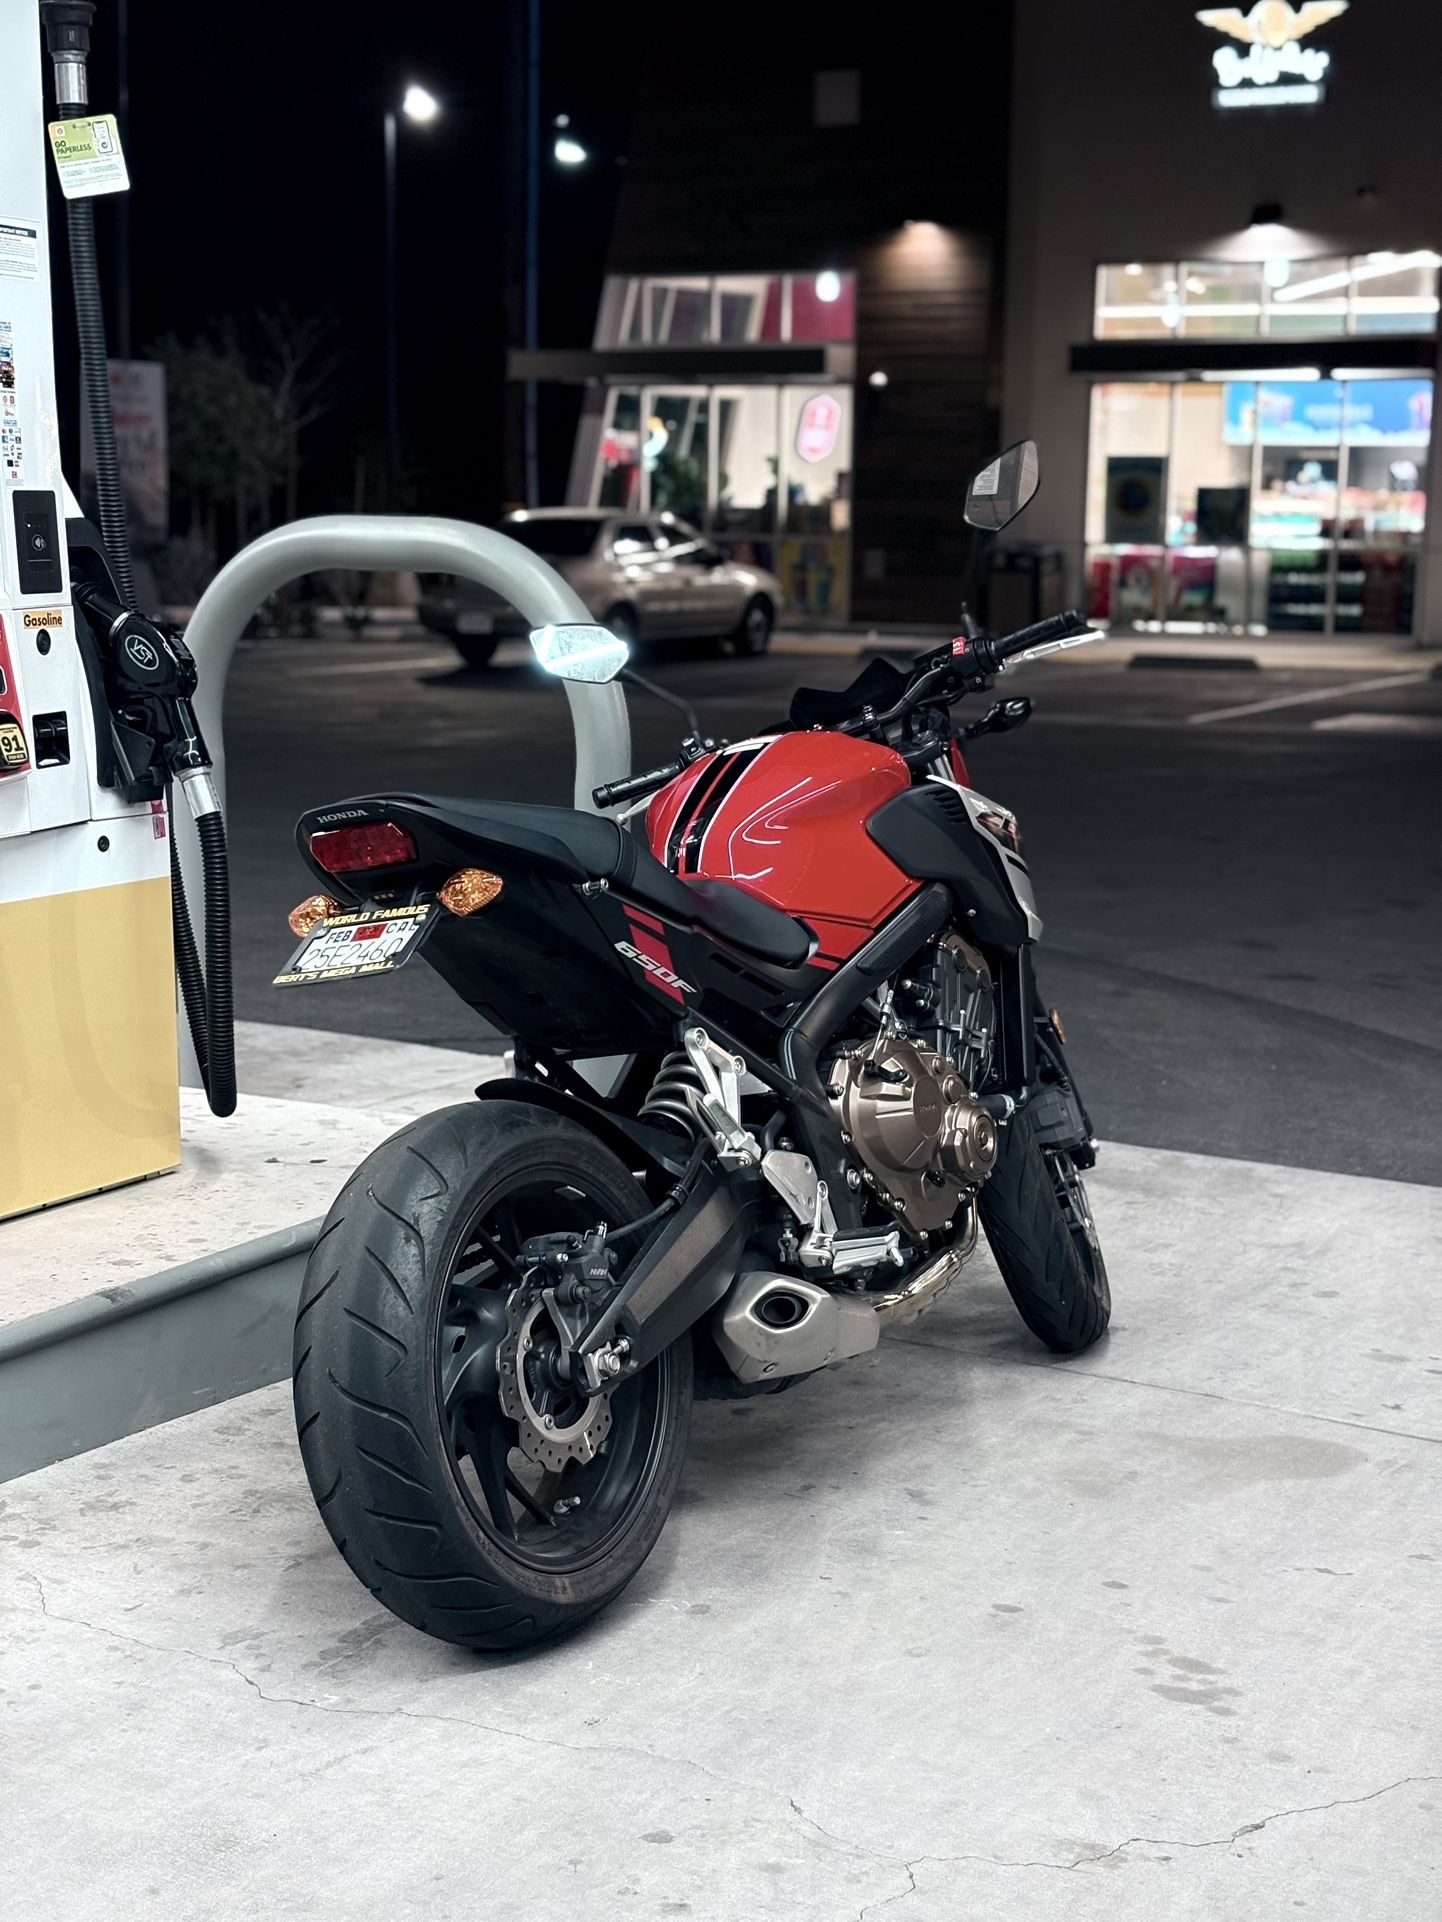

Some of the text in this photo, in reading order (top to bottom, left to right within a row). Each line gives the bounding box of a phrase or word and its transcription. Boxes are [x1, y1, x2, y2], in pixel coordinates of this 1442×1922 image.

[55, 140, 66, 148] GO
[56, 143, 92, 155] PAPERLESS
[23, 612, 63, 627] Gasoline
[1, 735, 24, 753] 91
[316, 810, 369, 824] HONDA
[322, 904, 431, 927] WORLD FAMOUS
[325, 930, 353, 944] FEB
[319, 964, 356, 979] MEGA
[359, 960, 395, 972] MALL
[614, 940, 698, 993] 650F
